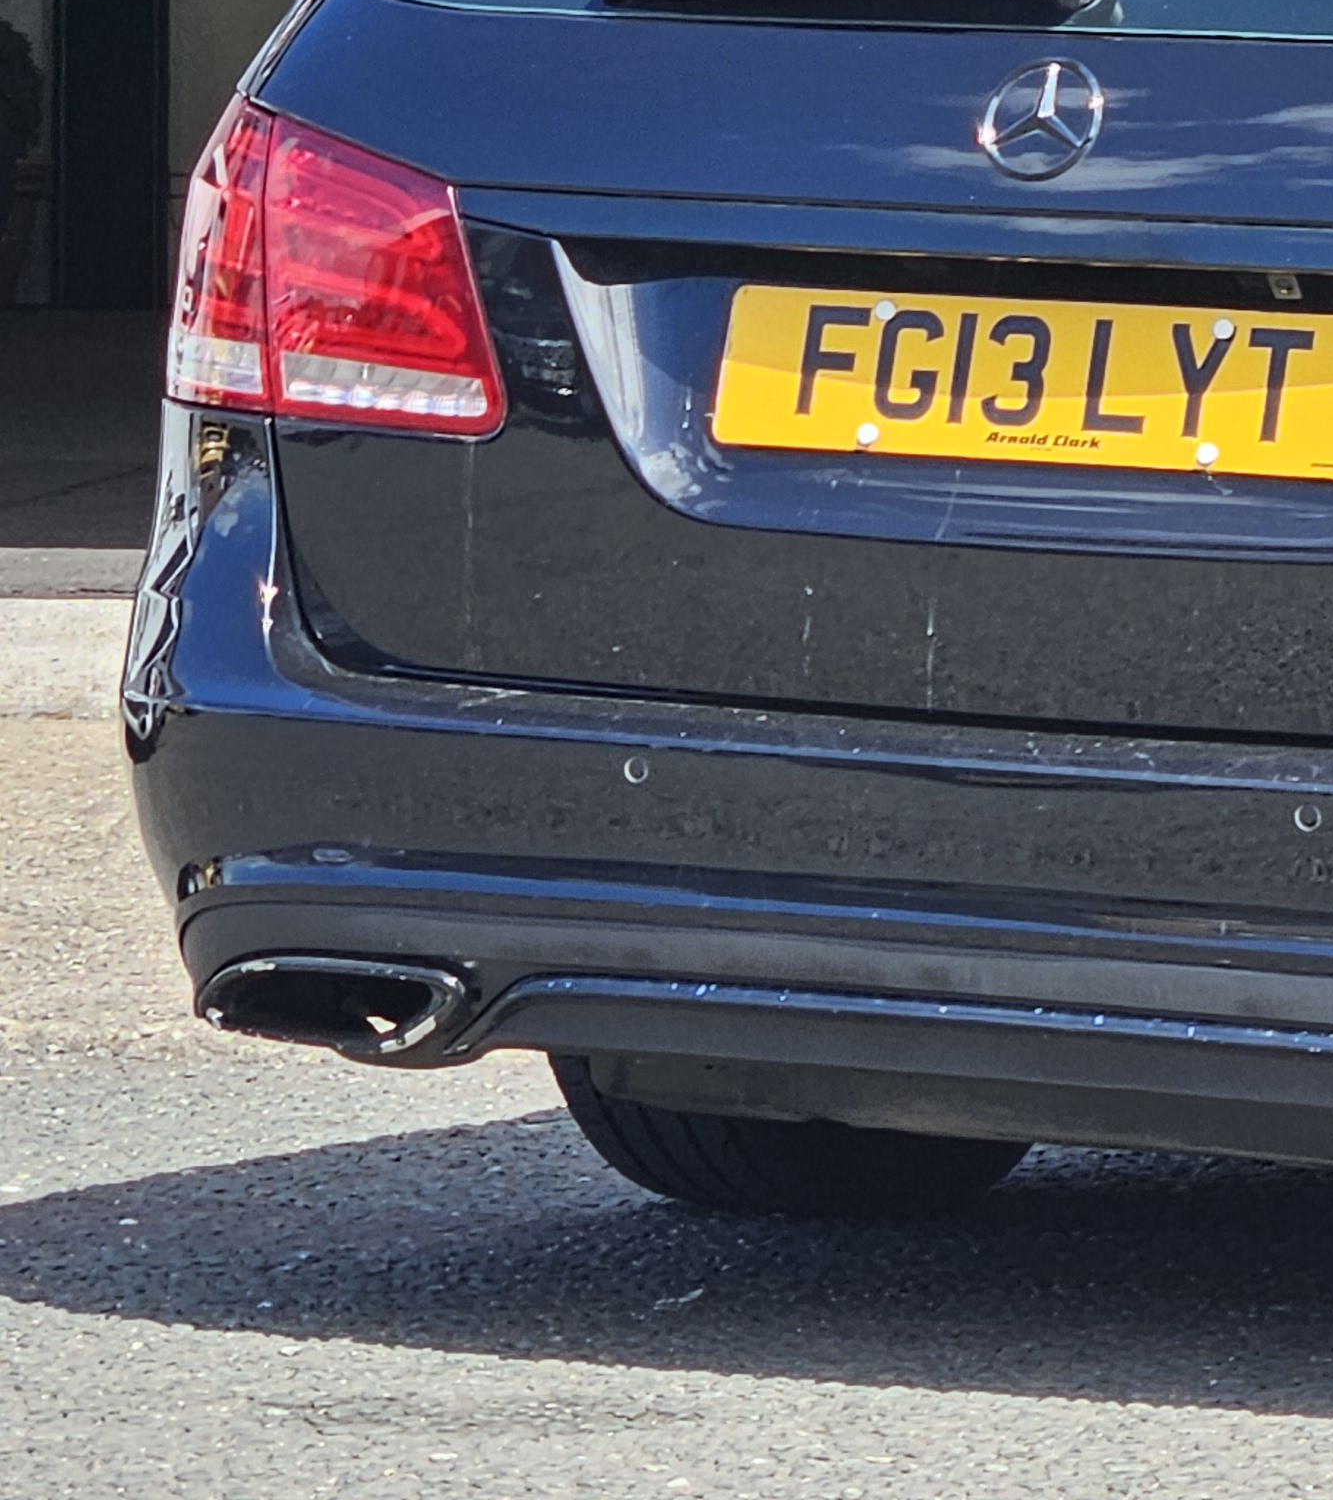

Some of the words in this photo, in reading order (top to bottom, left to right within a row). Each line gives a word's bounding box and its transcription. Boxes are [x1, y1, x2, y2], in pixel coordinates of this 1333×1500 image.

[795, 305, 1052, 427] FG13
[1081, 318, 1315, 443] LYT
[985, 431, 1049, 446] Arnold
[1052, 434, 1102, 449] Clark
